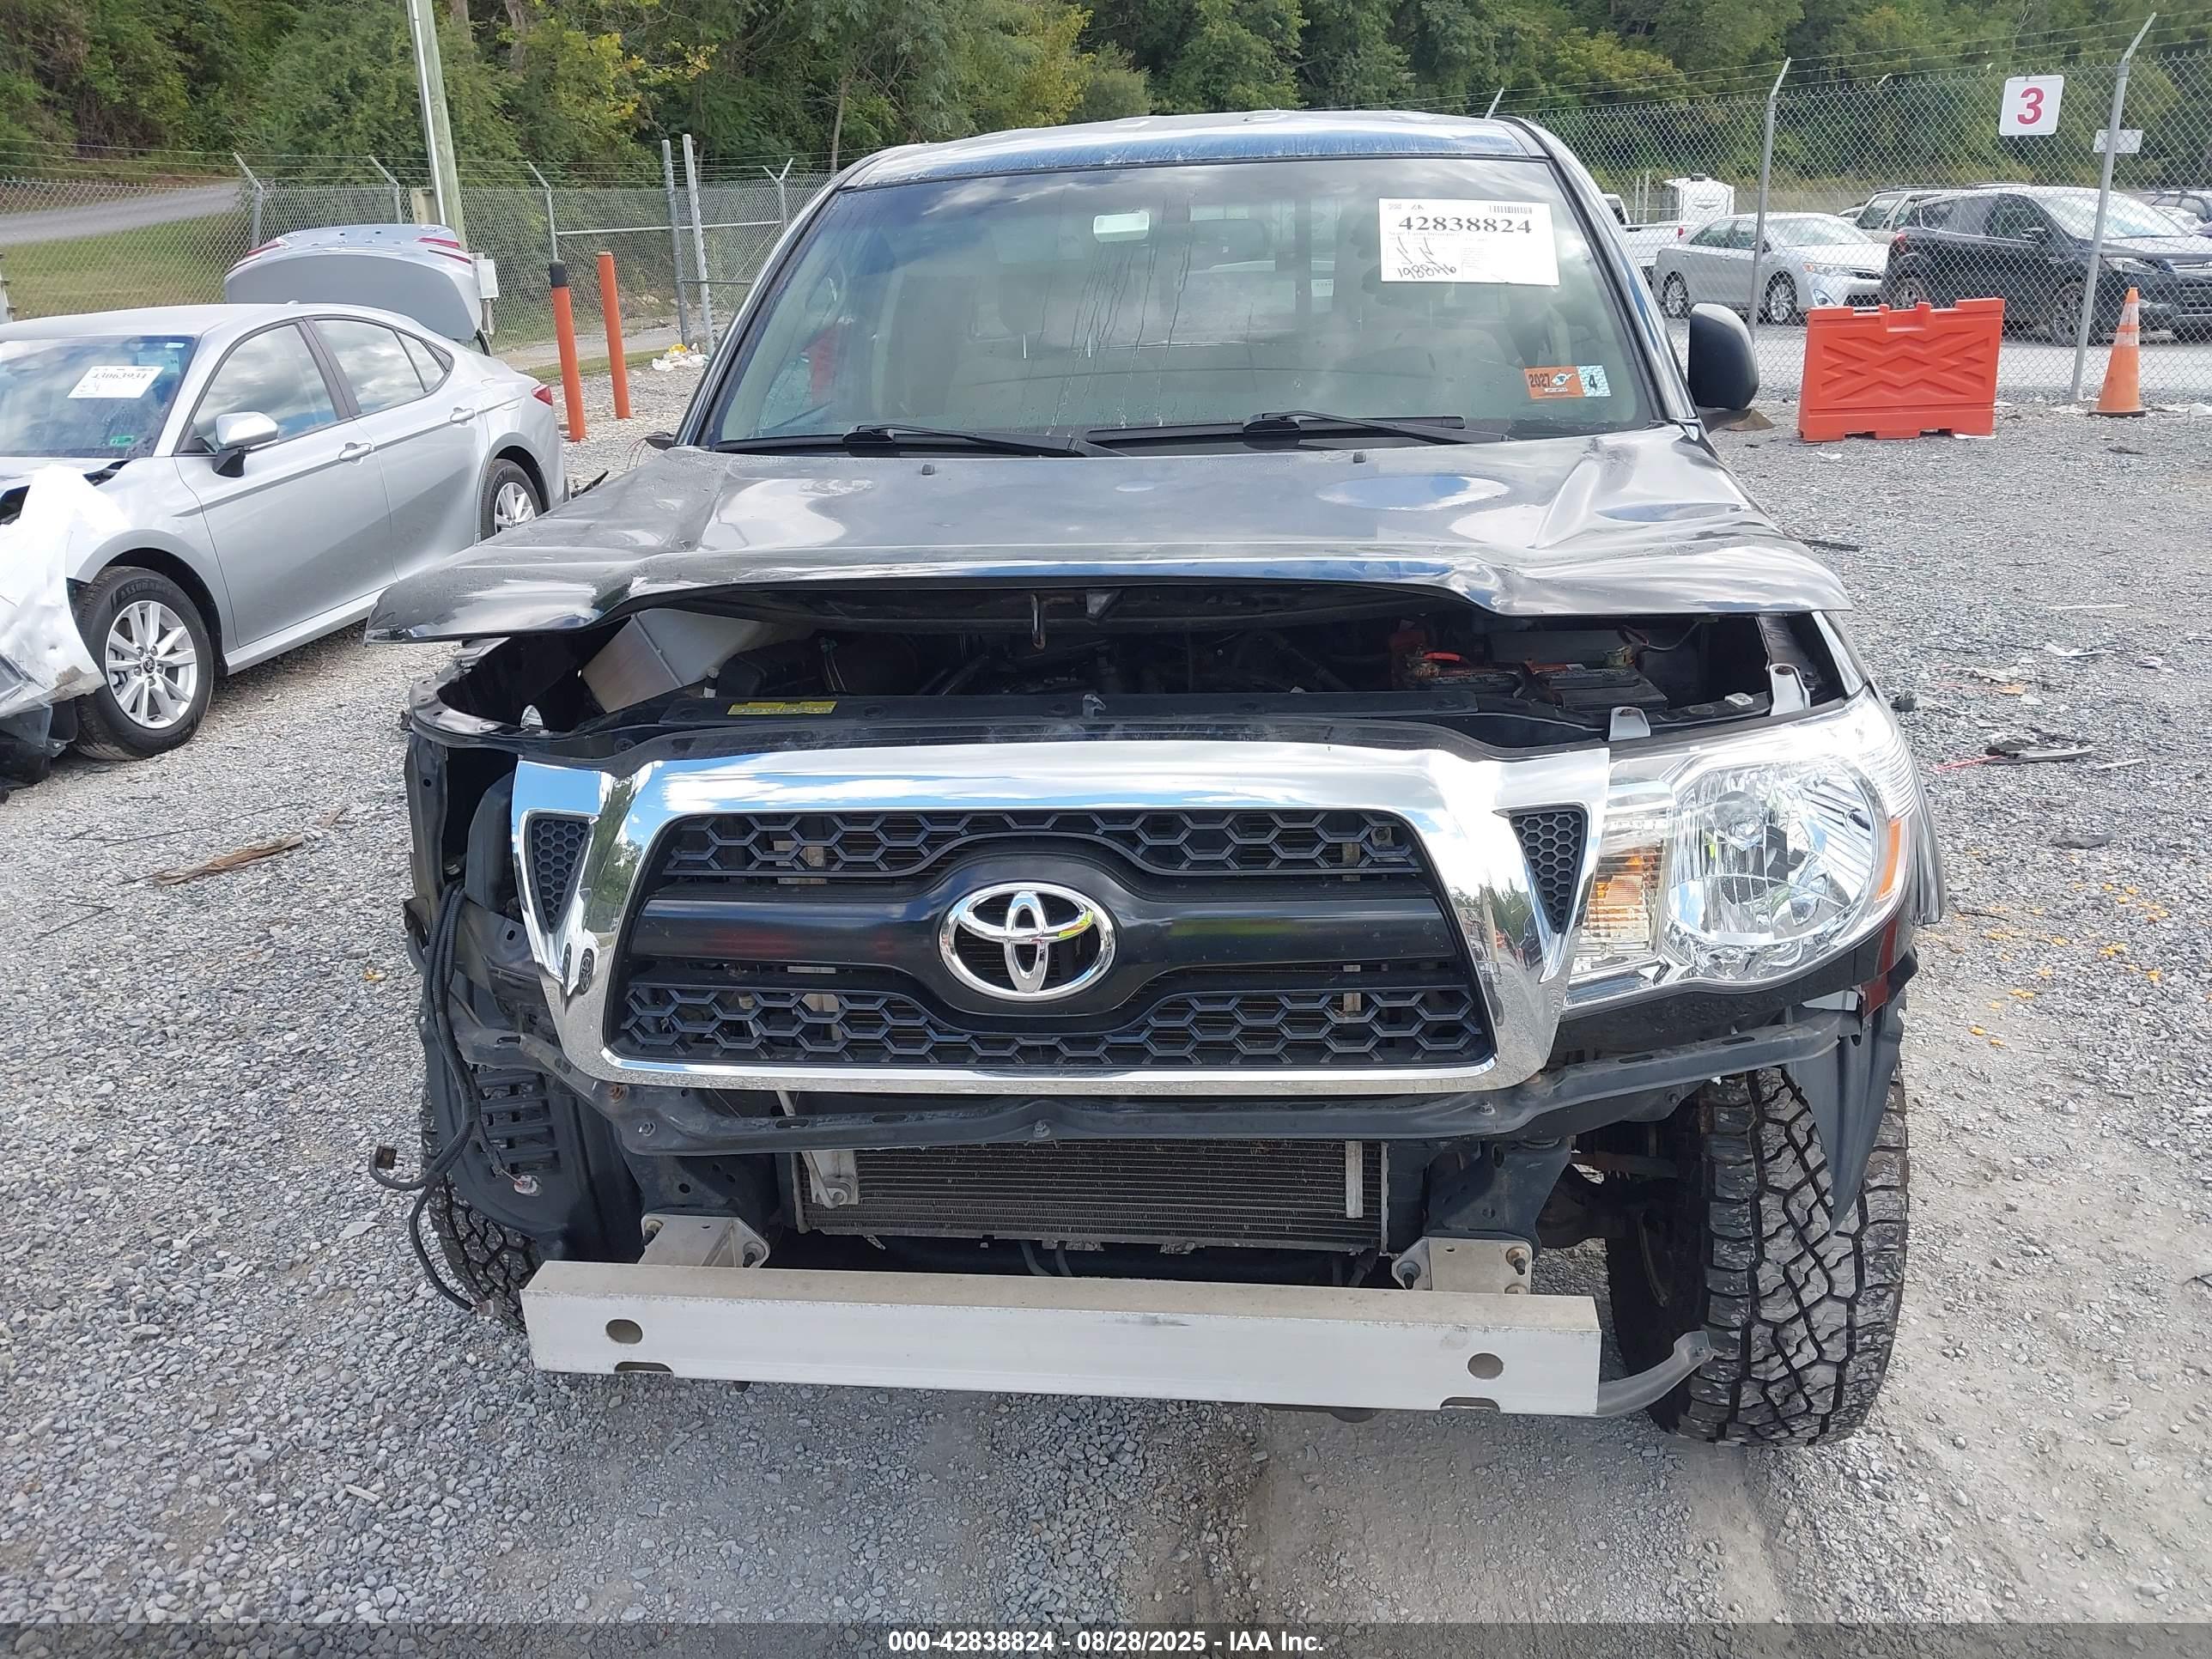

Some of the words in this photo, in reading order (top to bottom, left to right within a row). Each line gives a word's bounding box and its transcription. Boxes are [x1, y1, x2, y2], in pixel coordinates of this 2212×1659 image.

[2017, 88, 2045, 125] 3
[1398, 216, 1532, 234] 42838824
[1528, 373, 1551, 388] 2027
[1588, 374, 1597, 391] 4
